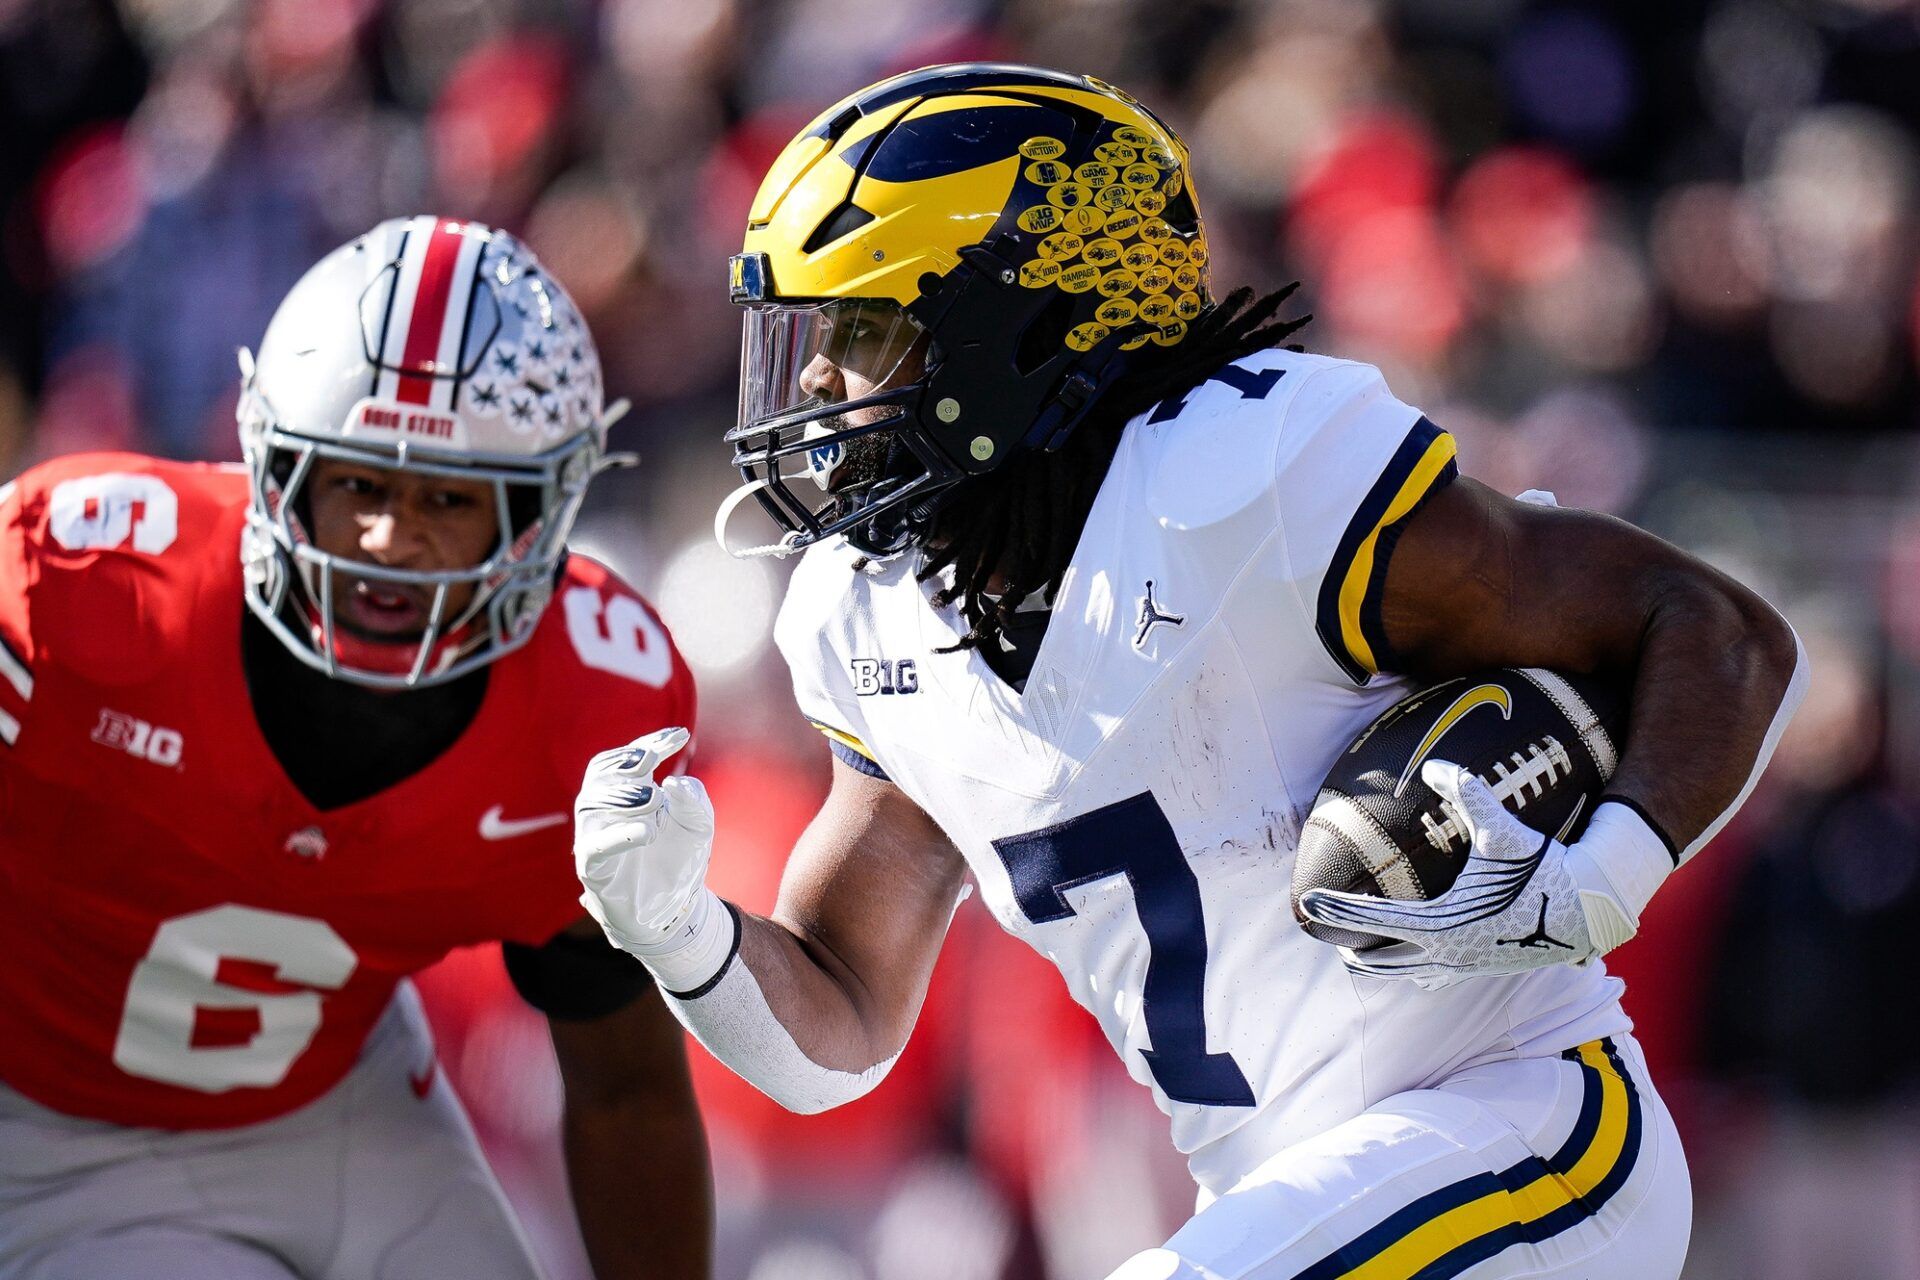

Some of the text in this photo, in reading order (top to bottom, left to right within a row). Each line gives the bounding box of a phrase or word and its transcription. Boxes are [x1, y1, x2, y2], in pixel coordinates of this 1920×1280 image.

[1026, 146, 1059, 156] VICTORY
[1081, 167, 1109, 178] GAME
[1091, 178, 1106, 186] 975
[1029, 218, 1055, 231] MVP
[1066, 240, 1080, 249] 983
[1042, 265, 1059, 276] 1009
[1061, 268, 1095, 283] RAMPAGE
[1073, 280, 1088, 290] 2022
[1120, 280, 1133, 291] 982
[1120, 310, 1131, 319] 981
[1094, 329, 1105, 339] 981
[364, 408, 453, 438] OHIO STATE
[810, 442, 841, 472] M
[562, 587, 673, 688] 6
[990, 789, 1257, 1107] 7
[113, 902, 359, 1094] 6
